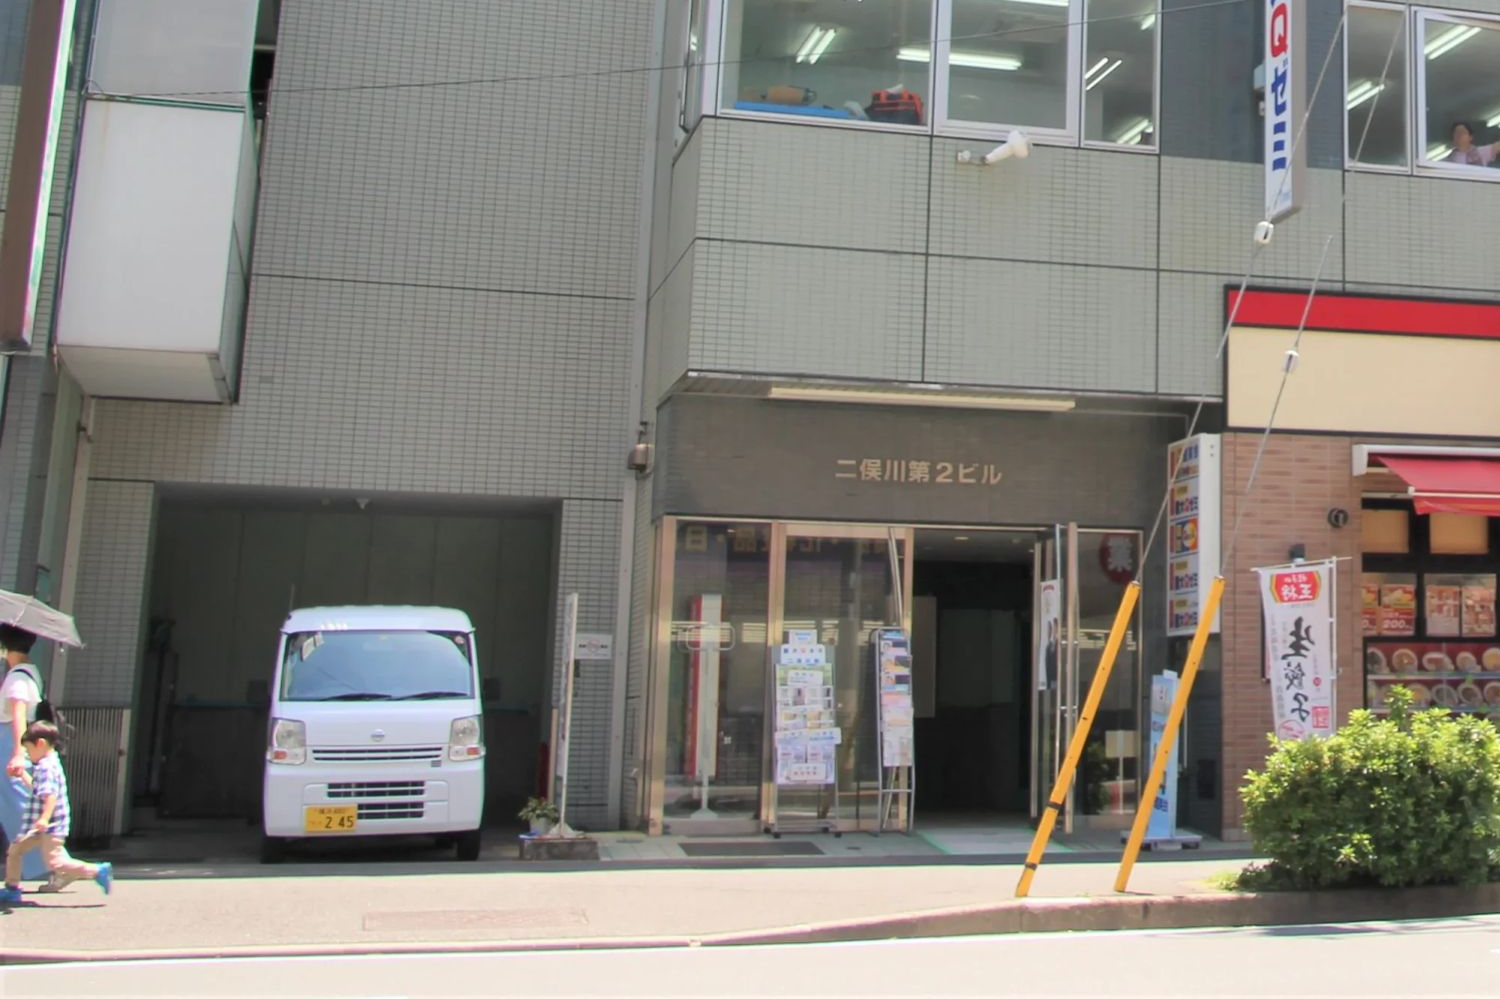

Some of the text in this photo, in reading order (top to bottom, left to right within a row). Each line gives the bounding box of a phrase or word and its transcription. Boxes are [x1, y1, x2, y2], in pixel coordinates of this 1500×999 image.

[835, 458, 1002, 486] 二俣川第2ビル
